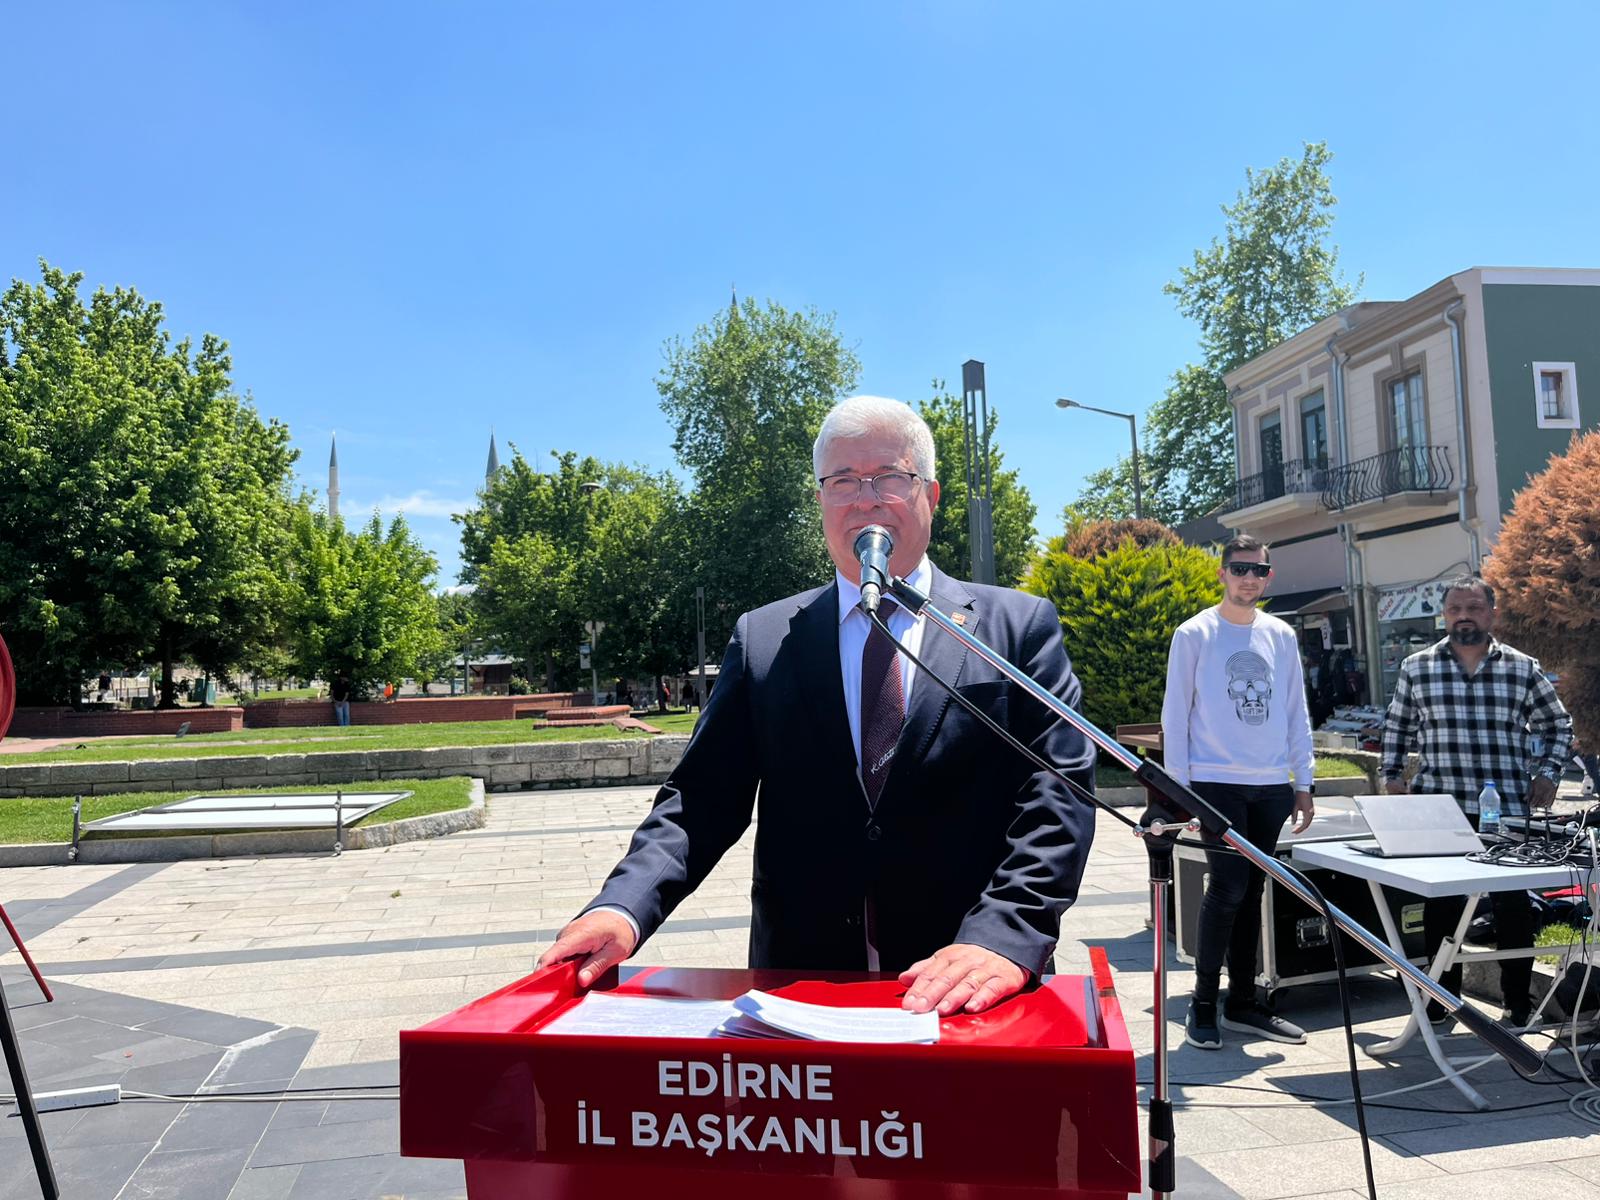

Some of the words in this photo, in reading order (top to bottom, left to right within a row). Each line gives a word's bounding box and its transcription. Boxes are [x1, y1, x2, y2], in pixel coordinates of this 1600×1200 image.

[658, 1053, 833, 1101] EDİRNE
[578, 1100, 616, 1145] İL
[631, 1110, 923, 1159] BAŞKANLIĞI
